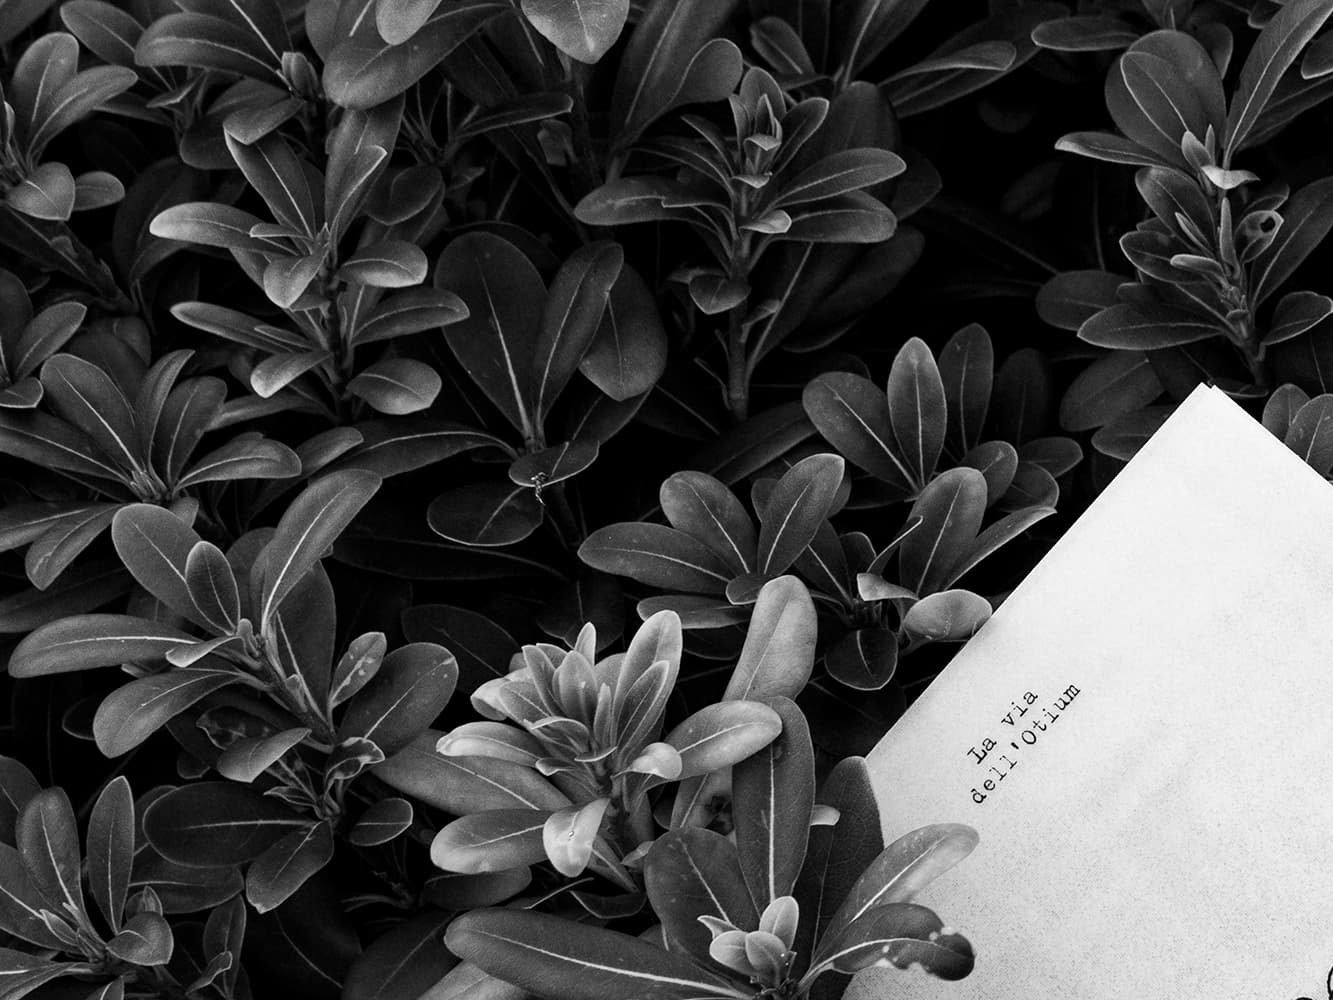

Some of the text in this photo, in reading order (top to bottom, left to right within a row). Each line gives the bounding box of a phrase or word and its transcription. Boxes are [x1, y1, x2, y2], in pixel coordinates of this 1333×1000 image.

[966, 691, 1039, 765] La via
[970, 684, 1081, 804] dell'Otium
